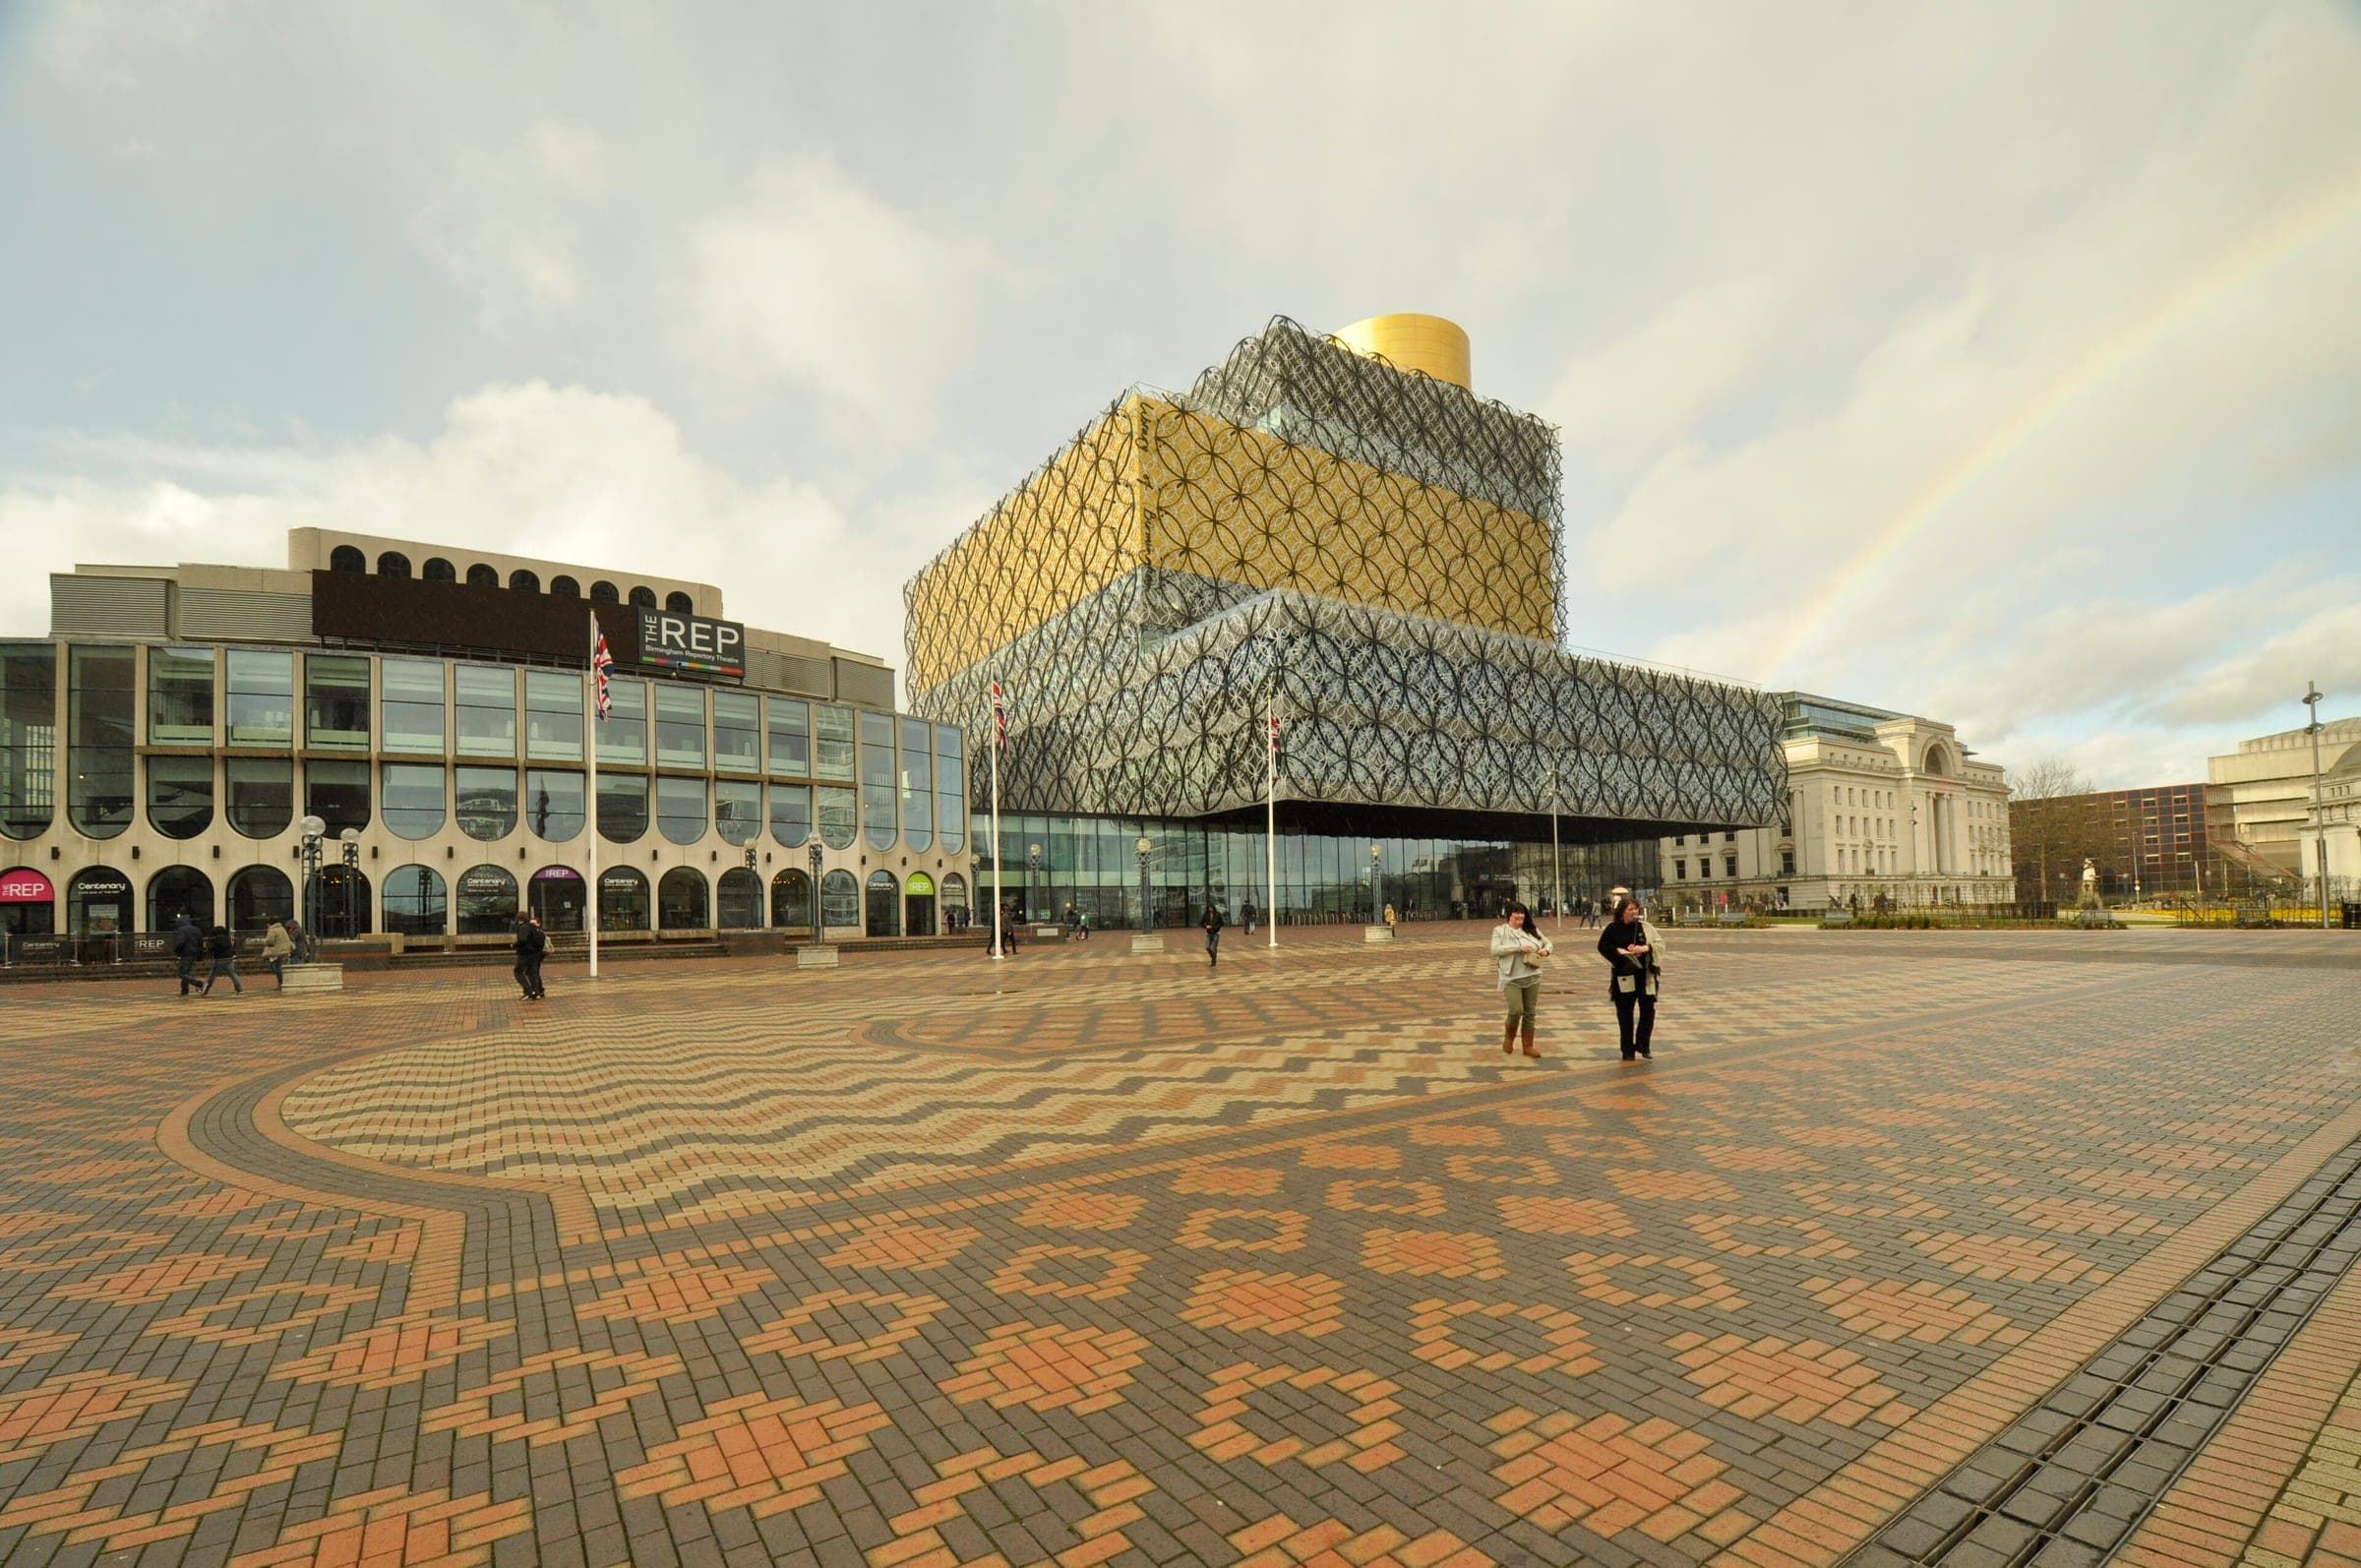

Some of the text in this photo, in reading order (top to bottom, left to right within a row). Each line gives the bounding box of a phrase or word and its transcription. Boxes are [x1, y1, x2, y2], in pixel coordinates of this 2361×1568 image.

[644, 615, 740, 654] THE REP
[645, 644, 740, 664] Birmingham Repertory Theatre
[10, 882, 45, 897] REP
[78, 882, 126, 891] Centenary
[913, 881, 930, 891] REP
[139, 939, 165, 948] REP
